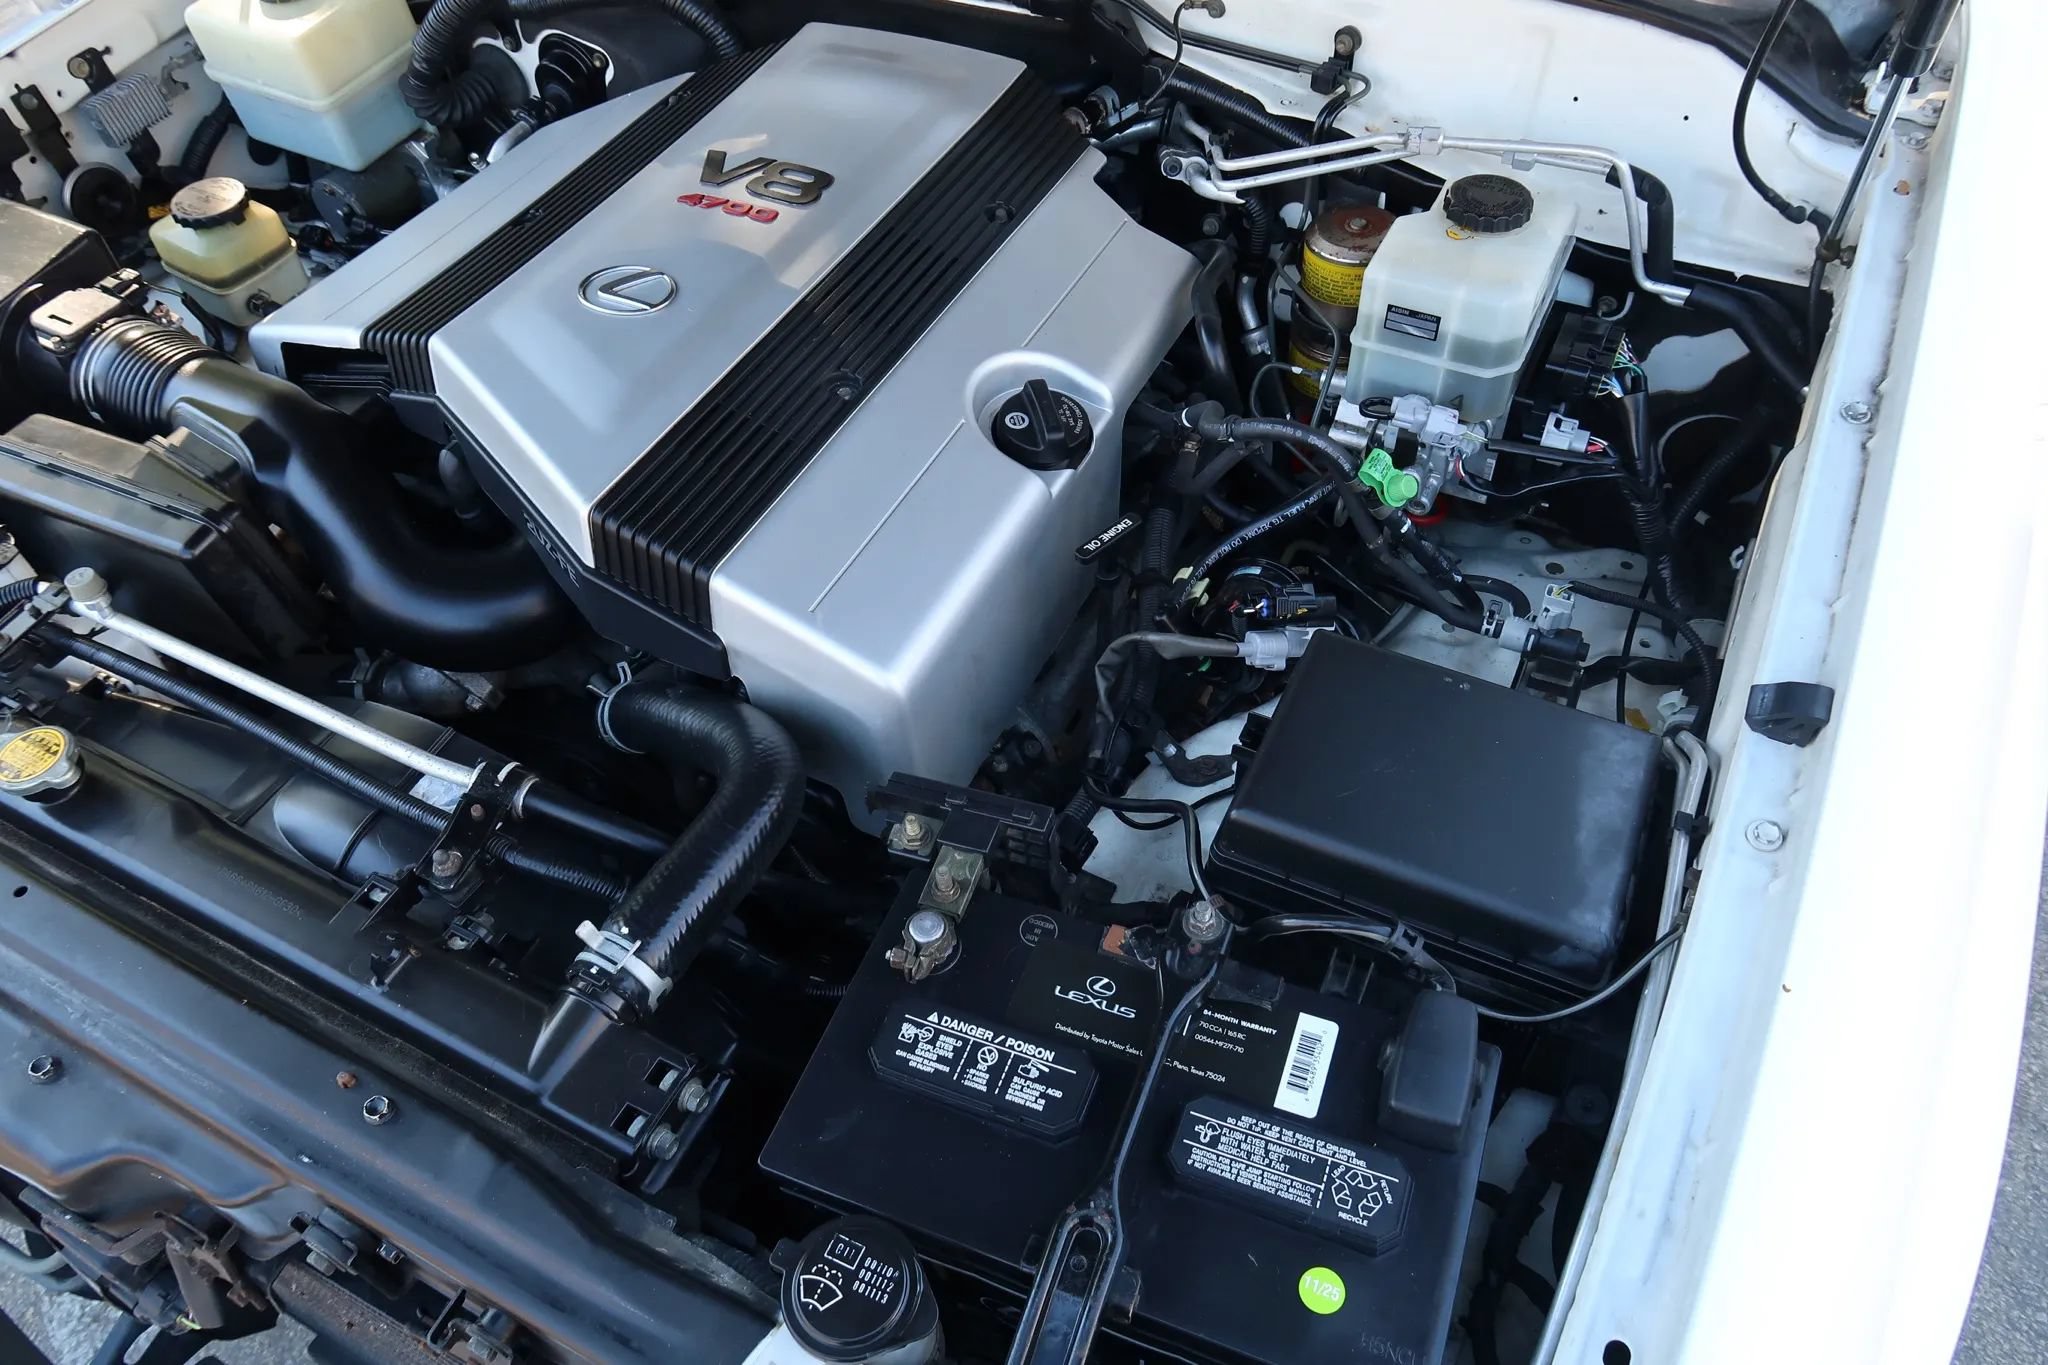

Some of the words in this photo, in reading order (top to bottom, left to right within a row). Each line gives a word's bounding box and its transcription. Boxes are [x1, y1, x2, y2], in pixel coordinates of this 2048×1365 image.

[700, 149, 835, 205] V8
[677, 193, 780, 224] 4700
[1098, 518, 1133, 542] ENGINE
[1083, 539, 1101, 551] OIL
[1231, 537, 1243, 548] DO
[1029, 918, 1054, 930] MEXICO
[1054, 985, 1136, 1018] LEXUS
[940, 1015, 994, 1041] DANGER
[1005, 1037, 1055, 1062] POISON
[1055, 1022, 1084, 1037] Distributed
[1091, 1034, 1107, 1044] Toyota
[1108, 1040, 1125, 1050] Motor
[1125, 1044, 1139, 1055] Sales
[1199, 1020, 1209, 1029] 710
[1209, 1024, 1223, 1034] CCA
[1228, 1030, 1238, 1038] 165
[1237, 1032, 1247, 1041] RC
[1240, 1020, 1278, 1035] WARRANTY
[918, 1041, 954, 1059] EXPLOSIVE
[936, 1040, 953, 1051] EYES
[939, 1034, 962, 1047] SHIELD
[896, 1049, 907, 1058] CAN
[915, 1048, 937, 1061] GASES
[977, 1063, 987, 1071] NO
[1190, 1065, 1205, 1077] Texas
[1205, 1070, 1226, 1083] 75024
[1010, 1082, 1022, 1091] CAN
[1013, 1075, 1046, 1092] SULFURIC
[1045, 1087, 1063, 1098] ACID
[1036, 1098, 1046, 1106] OR
[1220, 1134, 1239, 1148] WITH
[1268, 1151, 1283, 1162] GET
[1222, 1127, 1246, 1142] FLUSH
[1246, 1135, 1266, 1148] EYES
[1267, 1142, 1316, 1164] IMMEDIATELY
[1226, 1117, 1237, 1125] DO
[1236, 1120, 1250, 1129] NOT
[1264, 1130, 1281, 1139] KEEP
[1281, 1134, 1297, 1144] VENT
[1298, 1140, 1314, 1150] CAPS
[1316, 1145, 1334, 1157] TIGHT
[1334, 1152, 1348, 1161] AND
[1349, 1157, 1367, 1168] LEVEL
[1241, 1115, 1257, 1124] KEEP
[1257, 1121, 1270, 1130] OUT
[1282, 1128, 1294, 1137] THE
[1295, 1132, 1315, 1145] REACH
[1316, 1139, 1325, 1147] OF
[1326, 1142, 1356, 1158] CHILDREN
[1217, 1143, 1248, 1160] MEDICAL
[1250, 1153, 1270, 1166] HELP
[1270, 1160, 1290, 1173] FAST
[1190, 1153, 1231, 1172] INSTRUCTIONS
[1231, 1167, 1238, 1175] IN
[1239, 1169, 1262, 1183] VEHICLE
[1262, 1177, 1288, 1191] OWNERS
[1193, 1161, 1207, 1170] NOT
[1206, 1166, 1237, 1181] AVAILABLE
[1236, 1175, 1252, 1186] SEEK
[1252, 1181, 1276, 1194] SERVICE
[1218, 1156, 1231, 1166] FOR
[1230, 1160, 1246, 1170] SAFE
[1246, 1166, 1263, 1176] JUMP
[1263, 1171, 1291, 1186] STARTING
[1292, 1181, 1316, 1194] FOLLOW
[1331, 1164, 1346, 1178] LEAD
[1380, 1179, 1393, 1204] RETURN
[1338, 1211, 1368, 1227] RECYCLE
[852, 1280, 889, 1304] 001113
[858, 1268, 895, 1292] 001112
[1304, 1275, 1341, 1302] 11/25
